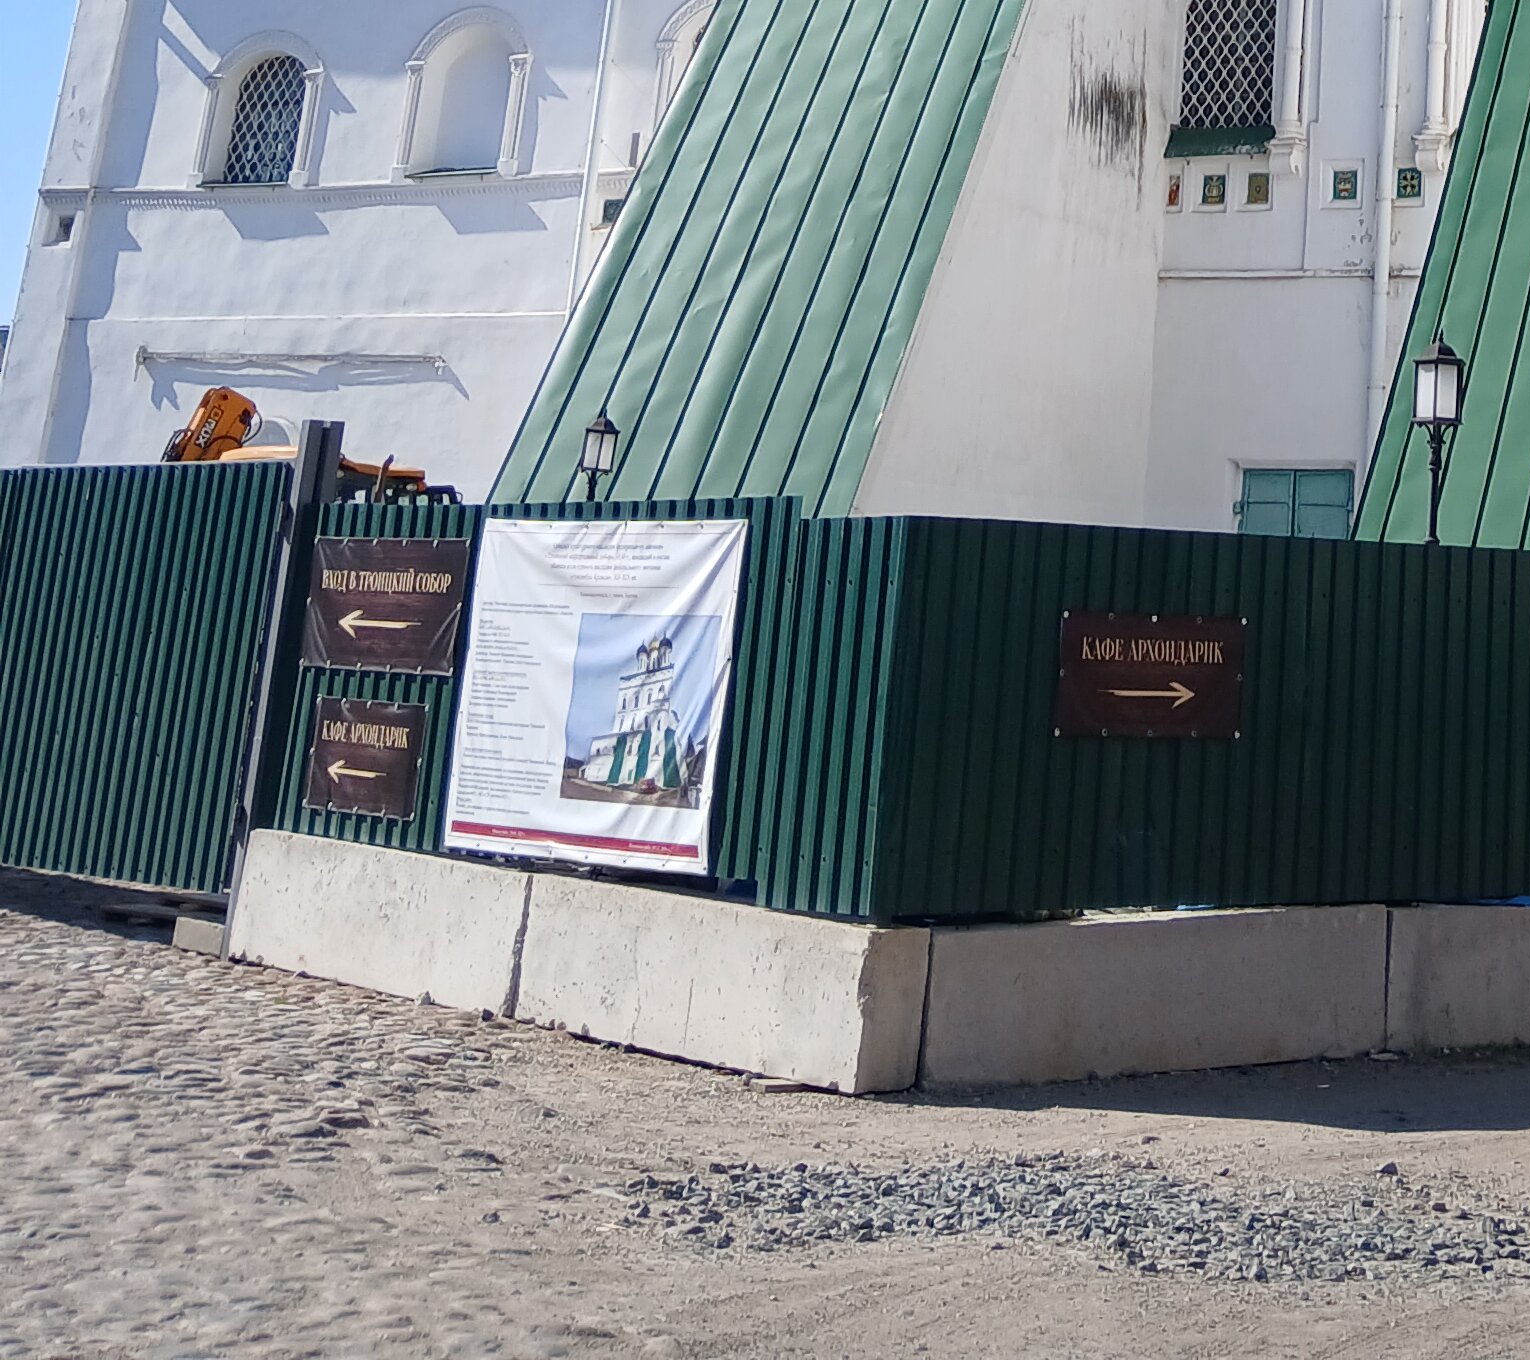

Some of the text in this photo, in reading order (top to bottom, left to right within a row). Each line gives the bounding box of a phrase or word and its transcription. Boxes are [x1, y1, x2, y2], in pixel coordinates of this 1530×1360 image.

[322, 568, 452, 595] ВХОД В ТРОИЦКИЙ СОБОР
[1081, 636, 1223, 667] КАФЕ АРХОНДАРИК
[322, 720, 410, 750] КАФЕ АРХОНДАРИК
